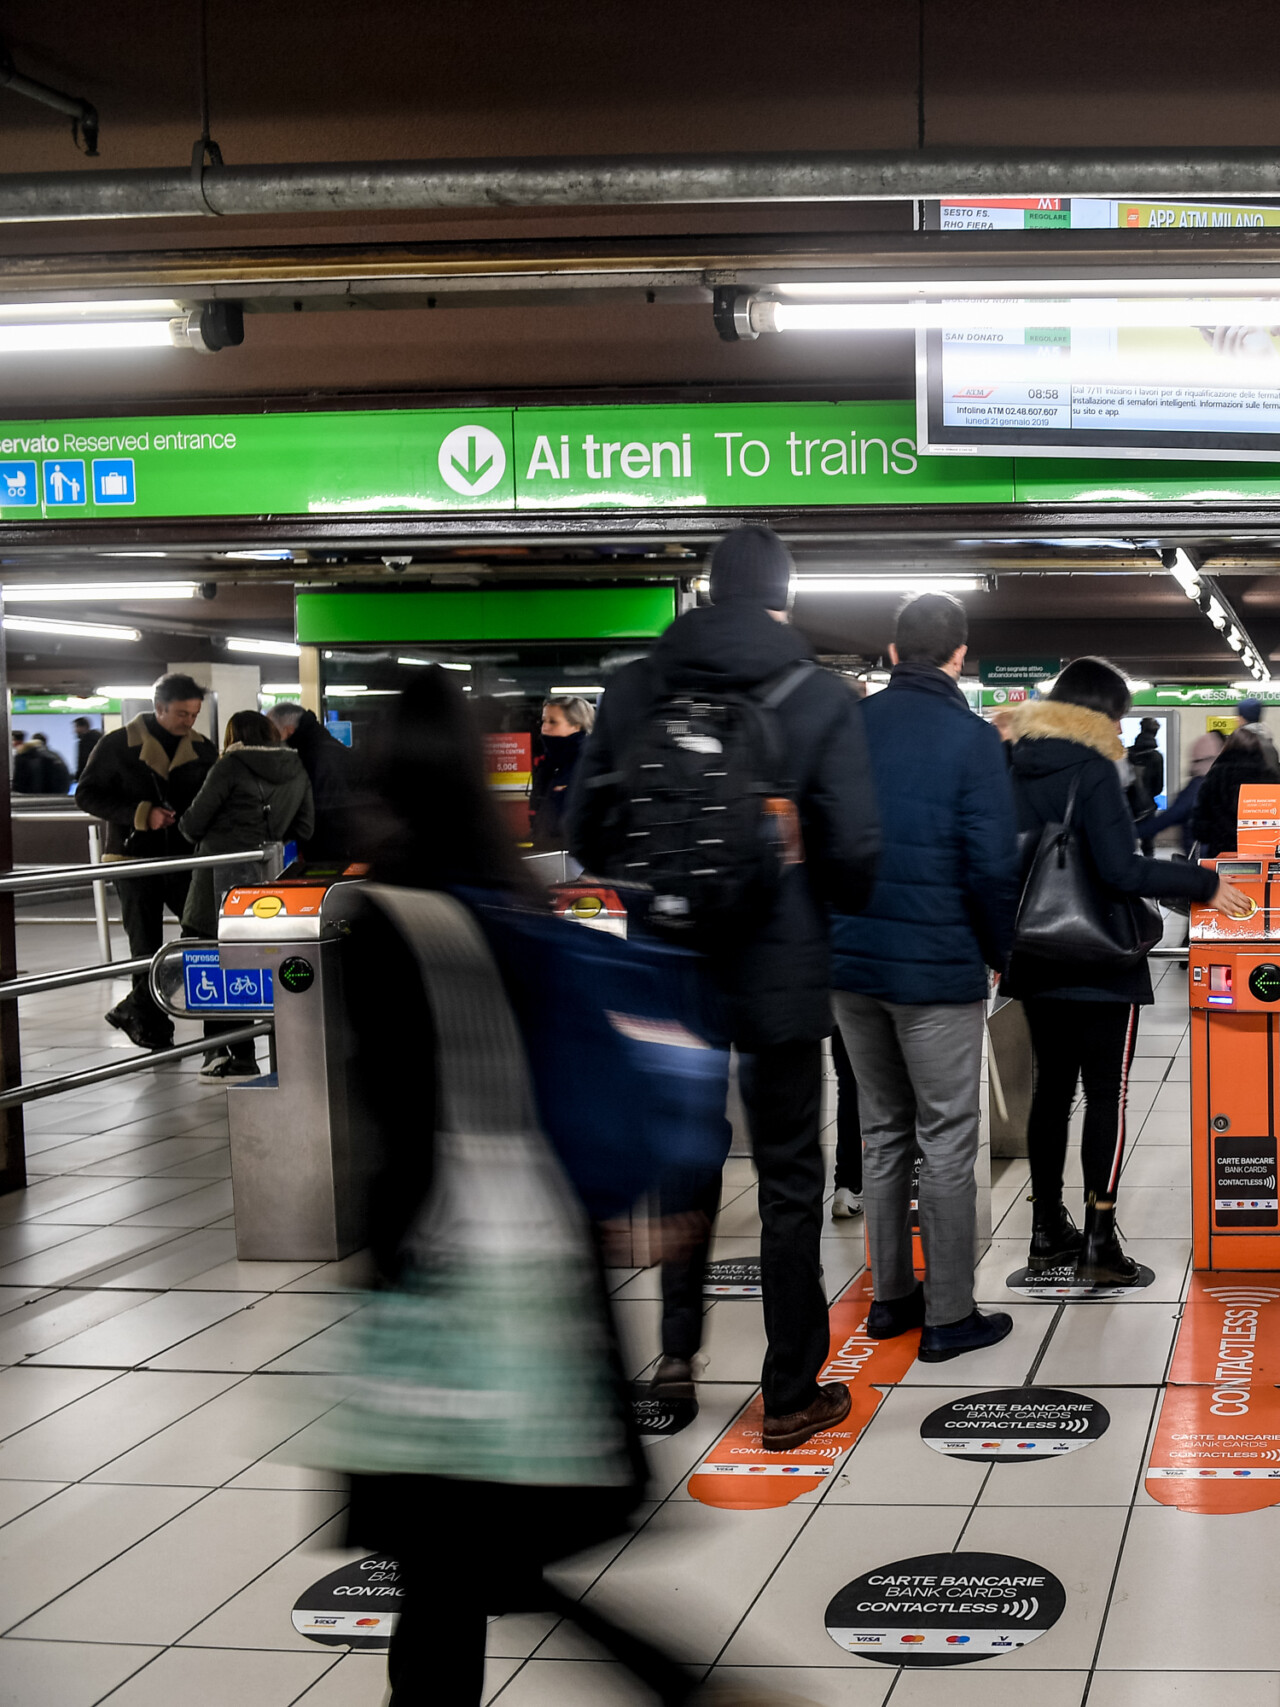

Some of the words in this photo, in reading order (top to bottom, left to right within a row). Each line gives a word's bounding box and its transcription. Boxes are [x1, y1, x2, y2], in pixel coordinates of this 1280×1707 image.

[1037, 198, 1059, 210] M1
[943, 208, 973, 217] SESTO
[1029, 213, 1068, 221] REGOLARE
[1149, 210, 1175, 228] APP
[1179, 211, 1209, 228] ATM
[944, 221, 963, 229] RHO
[967, 221, 994, 230] FIERA
[945, 333, 964, 341] SAN
[967, 334, 1004, 342] DONATO
[1028, 388, 1059, 400] 08:58
[1072, 386, 1084, 394] Dal
[1105, 387, 1132, 396] iniziano
[1139, 388, 1159, 396] lavori
[1161, 390, 1173, 399] per
[1175, 389, 1183, 397] di
[1184, 389, 1238, 399] riqualificazione
[1239, 391, 1256, 399] delle
[1072, 397, 1116, 406] installazione
[1118, 398, 1125, 406] di
[1127, 398, 1158, 406] semafori
[1200, 400, 1243, 409] Informazioni
[1245, 401, 1260, 409] sulle
[956, 406, 986, 415] Infoline
[999, 418, 1031, 427] gennaio
[63, 432, 149, 453] Reserved
[153, 431, 237, 450] entrance
[526, 434, 570, 479] Ai
[582, 433, 692, 479] treni
[714, 432, 770, 477] To
[786, 430, 918, 476] trains
[1010, 693, 1025, 701] M1
[1212, 720, 1227, 728] SOS
[185, 953, 219, 963] Ingresso
[1217, 1157, 1240, 1165] CARTE
[1241, 1157, 1275, 1165] BANCARIE
[1224, 1166, 1244, 1174] BANK
[1218, 1178, 1263, 1186] CONTACTLESS
[1209, 1309, 1259, 1416] CONTACTLESS
[952, 1403, 1007, 1412] CARTE
[1009, 1404, 1094, 1412] BANCARIE
[966, 1411, 1012, 1419] BANK
[1014, 1411, 1071, 1419] CARDS
[944, 1421, 1057, 1429] CONTACTLESS
[813, 1431, 853, 1439] CARIE
[1169, 1451, 1258, 1459] CONTACTLESS
[360, 1560, 399, 1570] CAR
[867, 1575, 938, 1587] CARTE
[940, 1576, 1046, 1587] BANCARIE
[332, 1586, 406, 1597] CONTAC
[885, 1587, 943, 1598] BANK
[946, 1587, 1017, 1598] CARDS
[856, 1602, 999, 1613] CONTACTLESS
